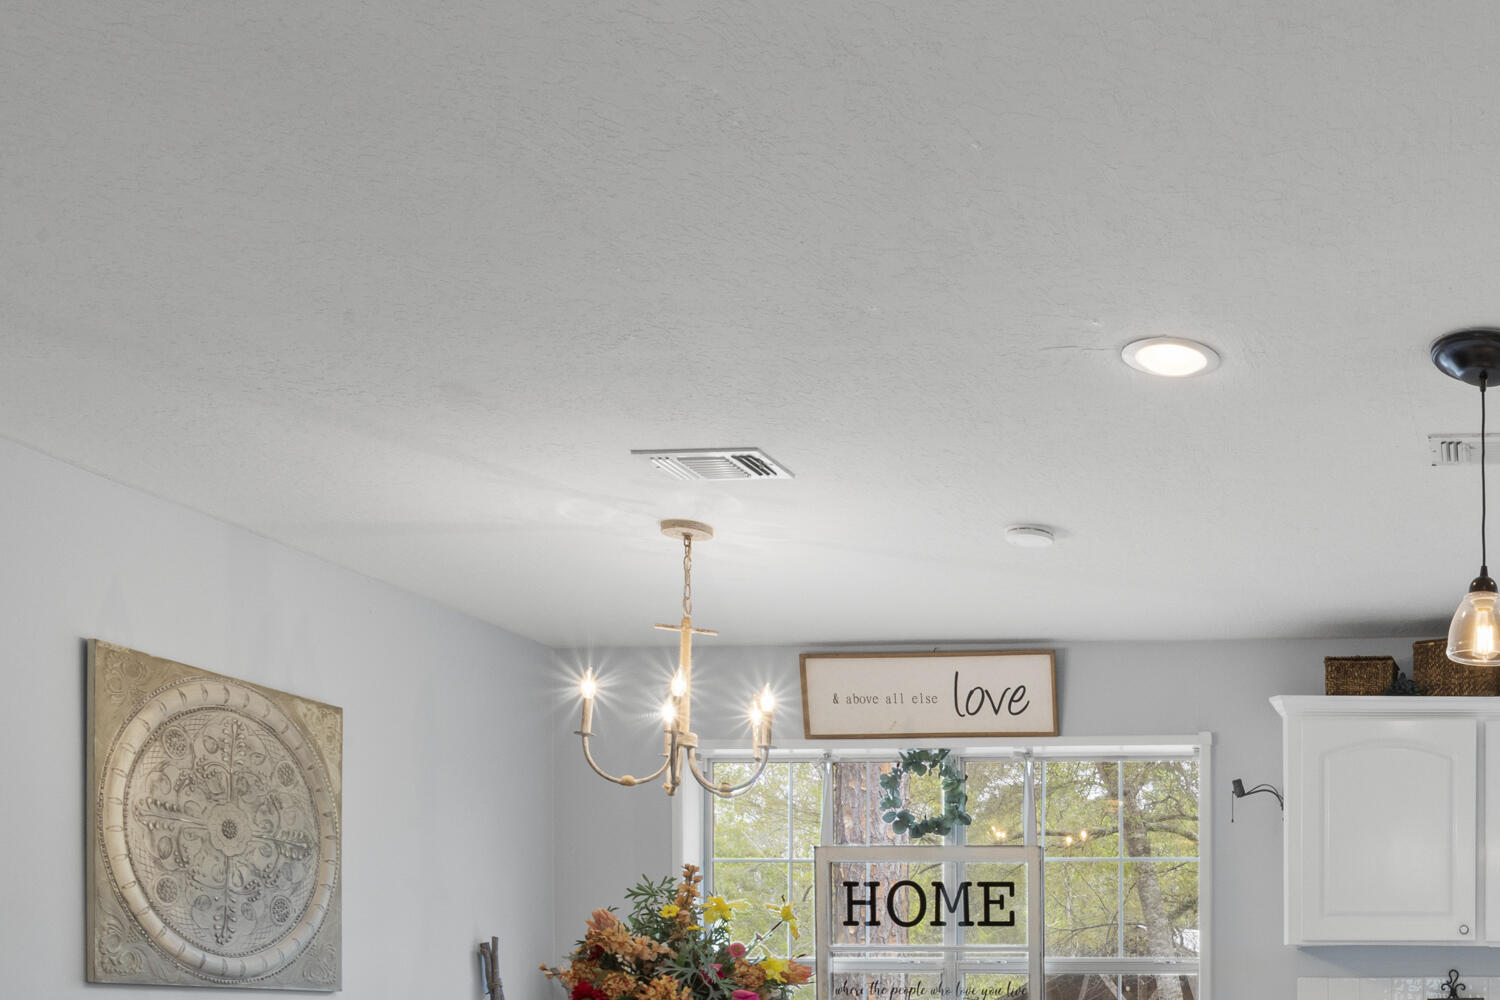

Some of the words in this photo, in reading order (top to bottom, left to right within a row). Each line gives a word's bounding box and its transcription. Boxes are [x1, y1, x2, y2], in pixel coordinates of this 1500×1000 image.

[832, 693, 839, 704] &
[846, 693, 879, 705] above
[885, 692, 904, 704] all
[911, 692, 938, 704] else
[954, 671, 1030, 718] love
[843, 880, 1016, 928] HOME
[835, 980, 864, 997] where
[869, 980, 888, 997] the
[930, 981, 952, 997] who
[955, 981, 980, 1000] love
[1006, 981, 1028, 997] live
